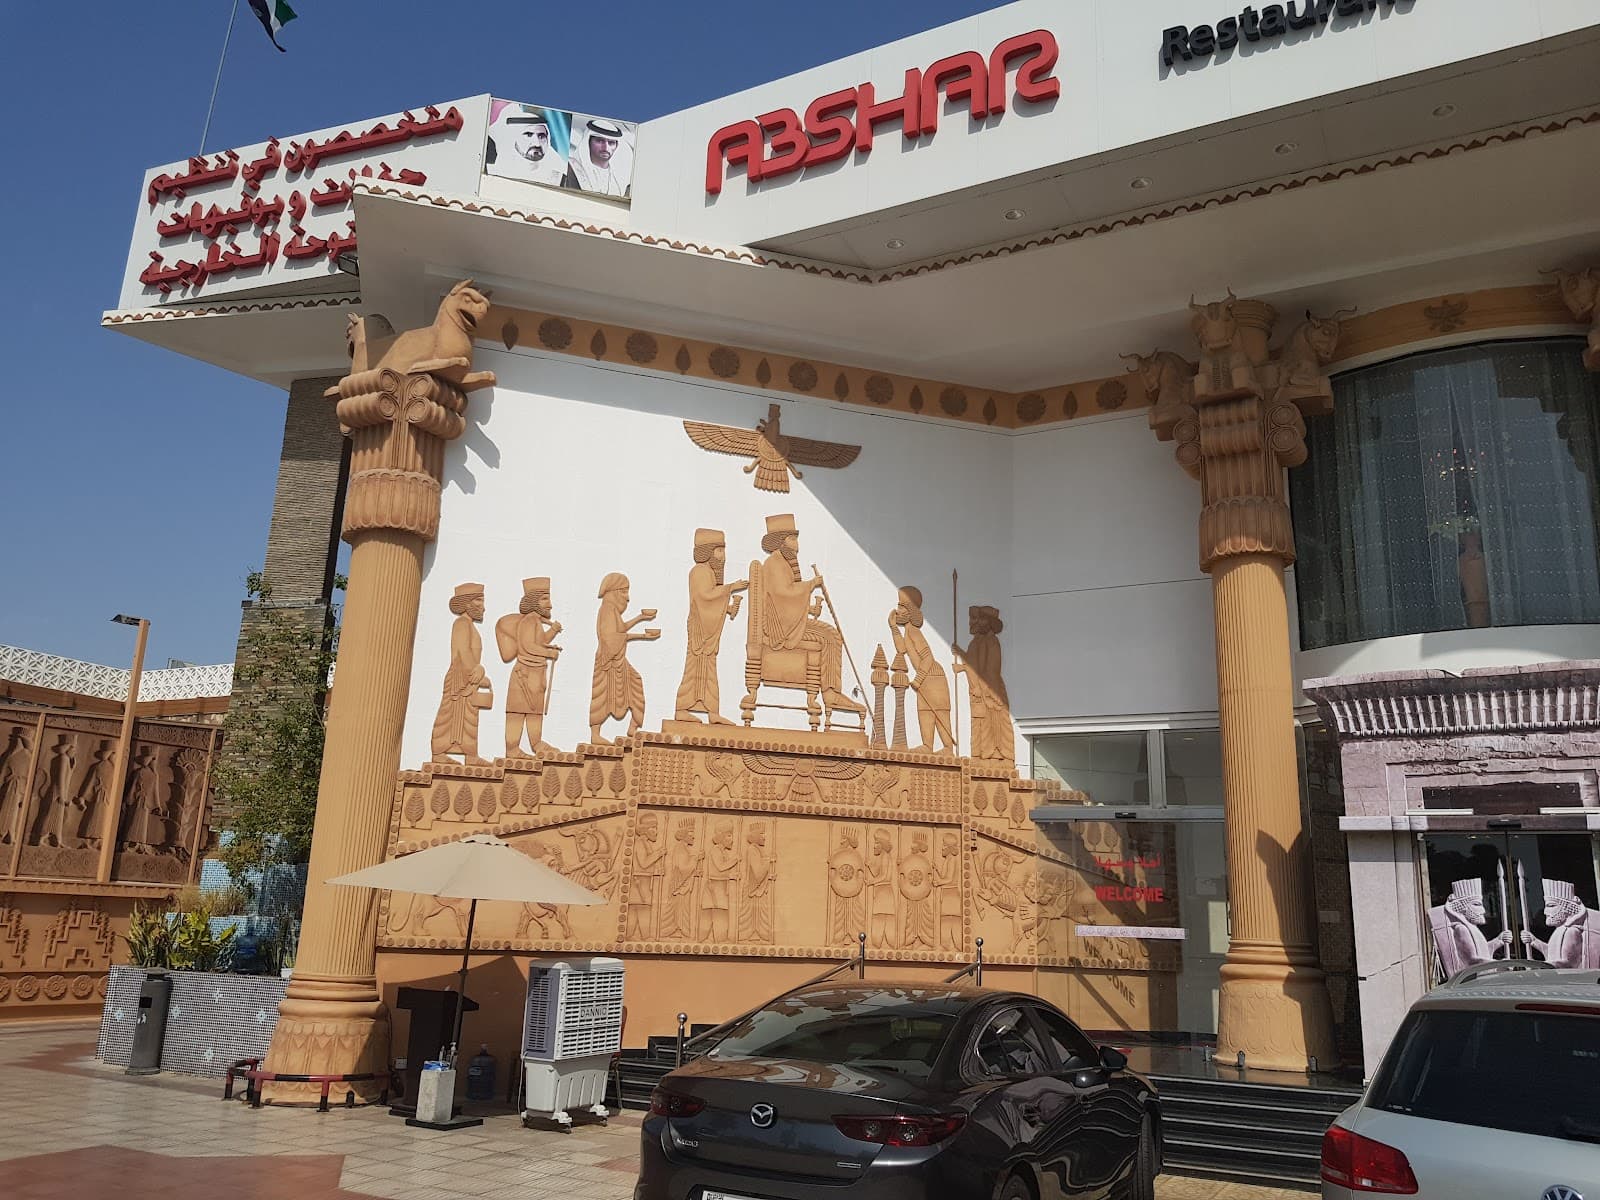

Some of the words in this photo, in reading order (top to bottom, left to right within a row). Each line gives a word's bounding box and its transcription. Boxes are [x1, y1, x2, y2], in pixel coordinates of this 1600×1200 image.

[1162, 0, 1397, 66] Restaur
[283, 104, 464, 173] متخصصون
[705, 28, 1061, 195] ABSHAR
[147, 149, 240, 207] تنظيم
[241, 136, 282, 191] في
[138, 230, 281, 295] الخارجية
[1095, 885, 1164, 902] WELCOME
